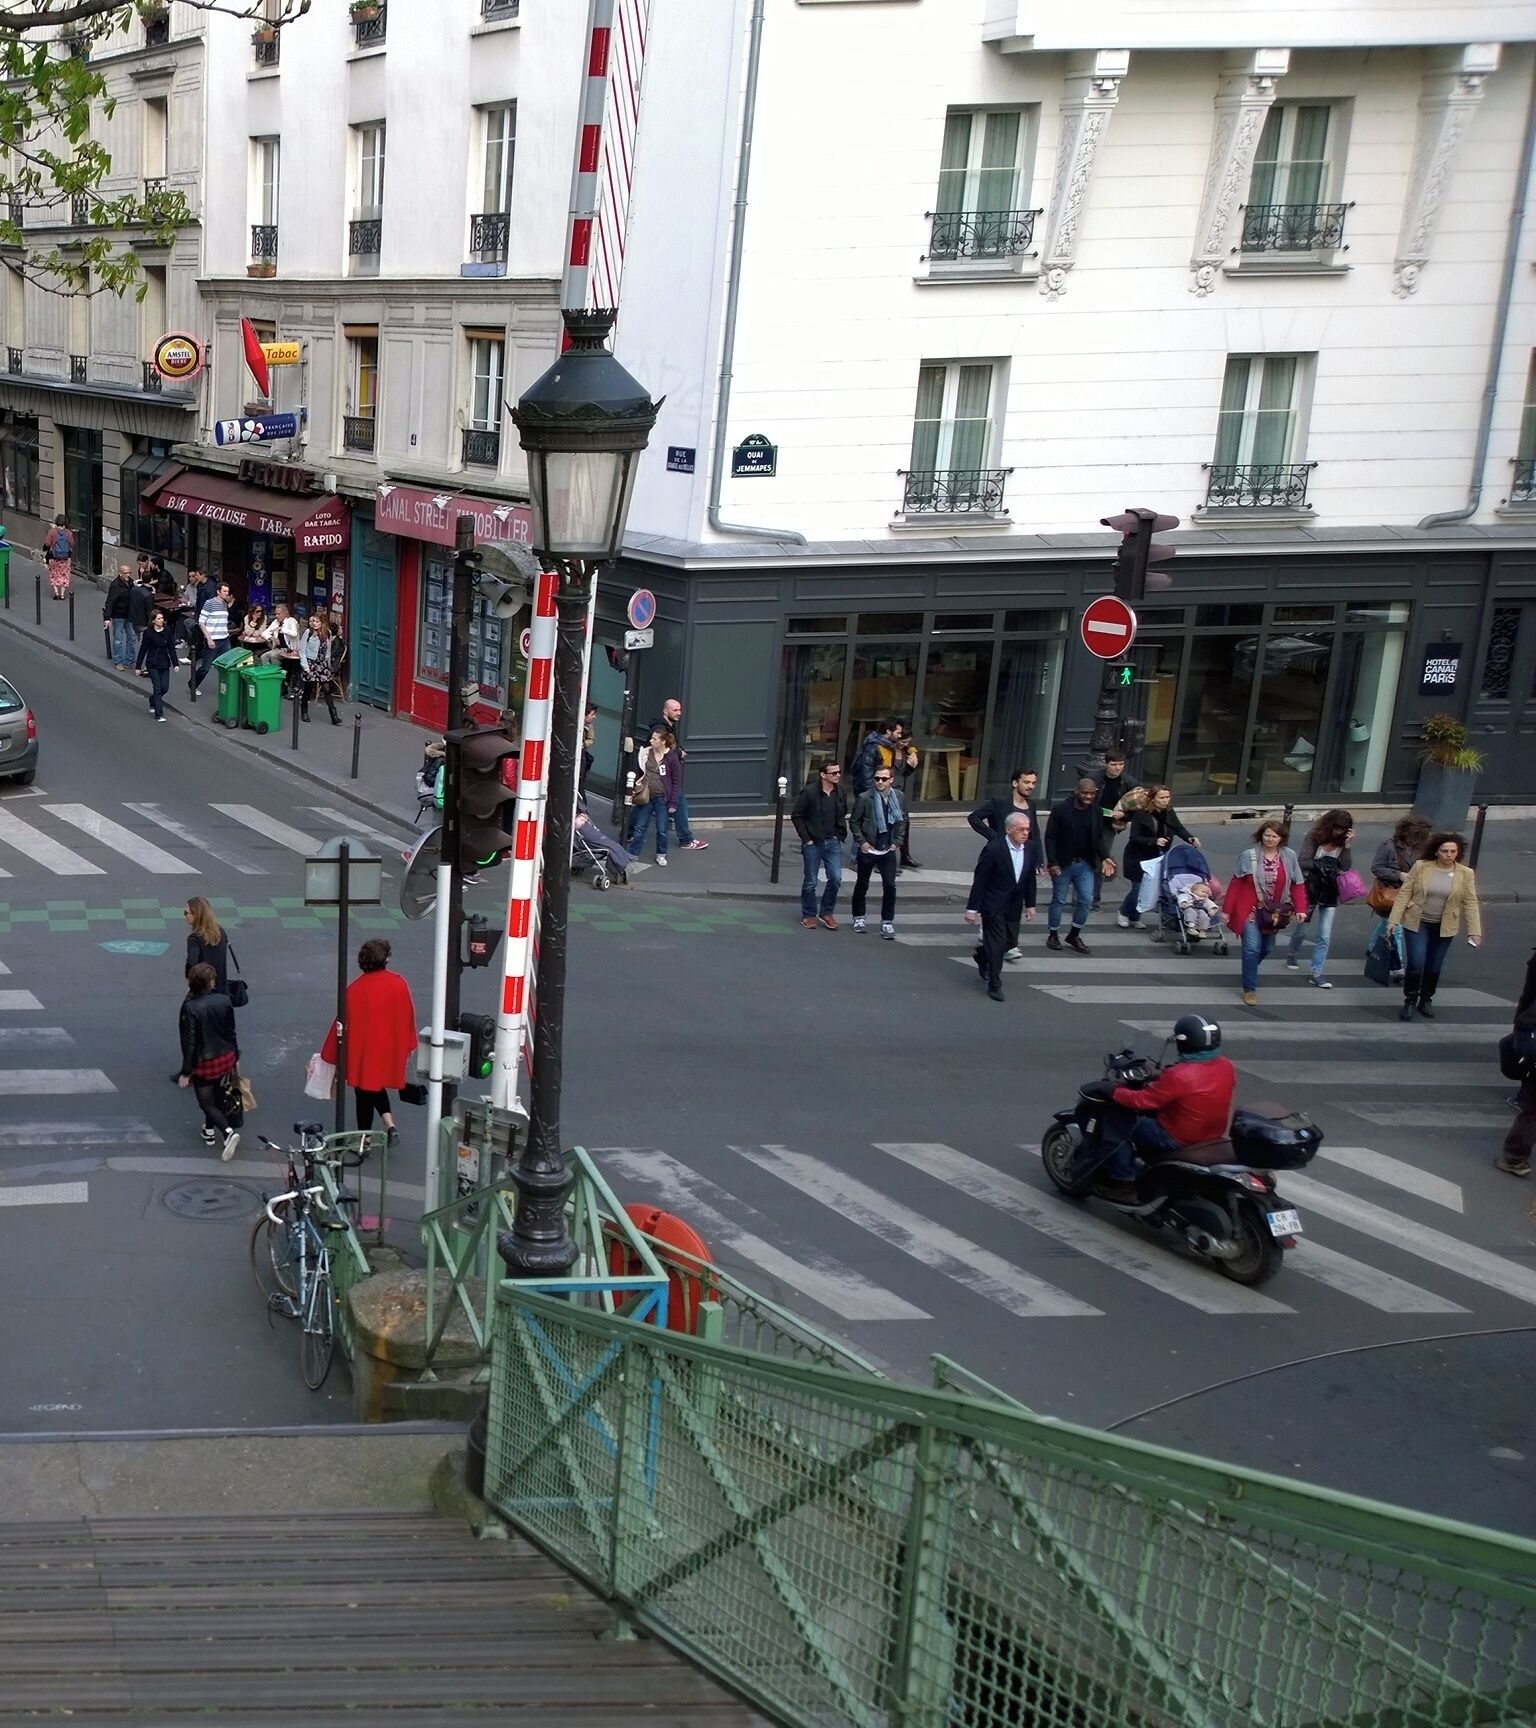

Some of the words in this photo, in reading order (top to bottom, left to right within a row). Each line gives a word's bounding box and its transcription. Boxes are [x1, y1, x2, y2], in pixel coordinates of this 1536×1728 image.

[266, 349, 297, 359] Tabac
[747, 451, 763, 459] QUAI
[736, 464, 772, 472] JEMMAPES
[167, 496, 187, 511] BAR
[196, 503, 247, 526] L'ECLUSE
[379, 497, 411, 522] CANAL
[414, 502, 450, 530] STREET
[315, 512, 331, 520] LOTO
[304, 534, 342, 547] RAPIDO
[1425, 665, 1456, 673] CANAL
